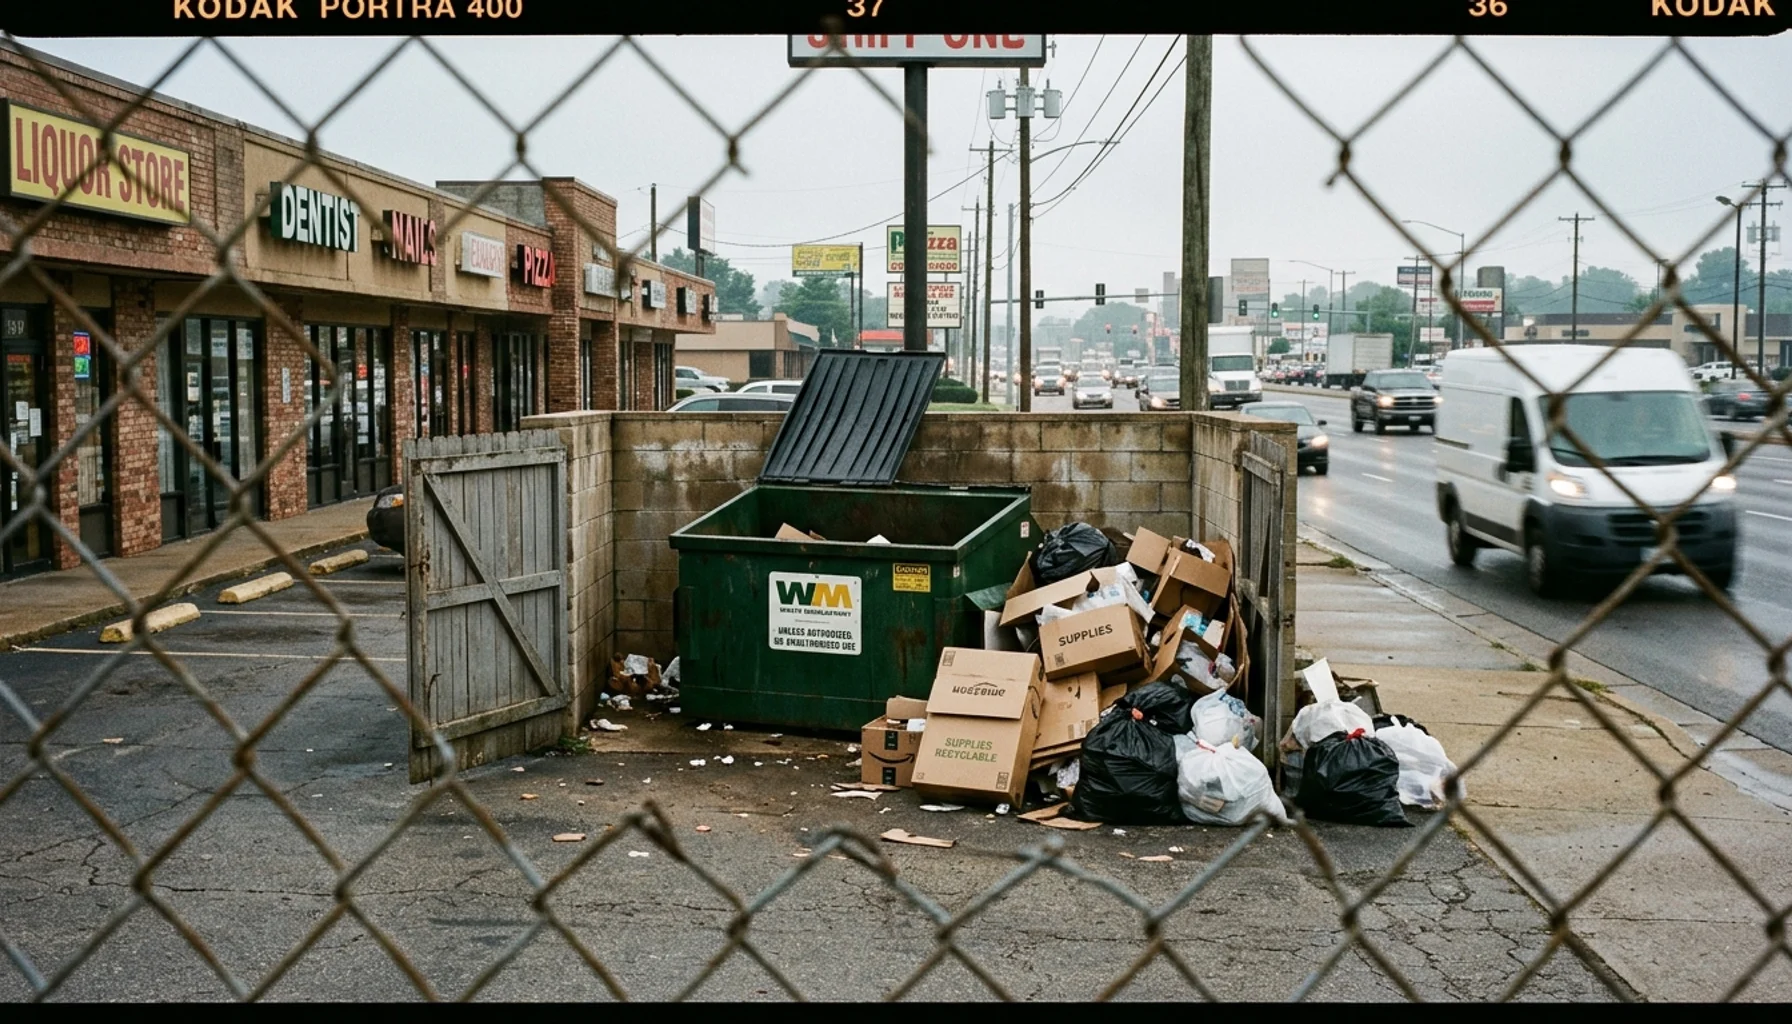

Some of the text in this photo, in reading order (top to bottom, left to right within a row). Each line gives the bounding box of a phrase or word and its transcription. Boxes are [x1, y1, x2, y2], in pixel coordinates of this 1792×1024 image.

[15, 117, 185, 212] LIQUOR STORE
[282, 183, 360, 253] DENTIST
[391, 210, 436, 267] NAILS
[524, 245, 556, 288] PIZZA
[775, 580, 853, 609] WM
[1058, 623, 1113, 647] SUPPLIES
[934, 748, 998, 763] RECYCLABLE
[945, 737, 993, 751] SUPPLIES
